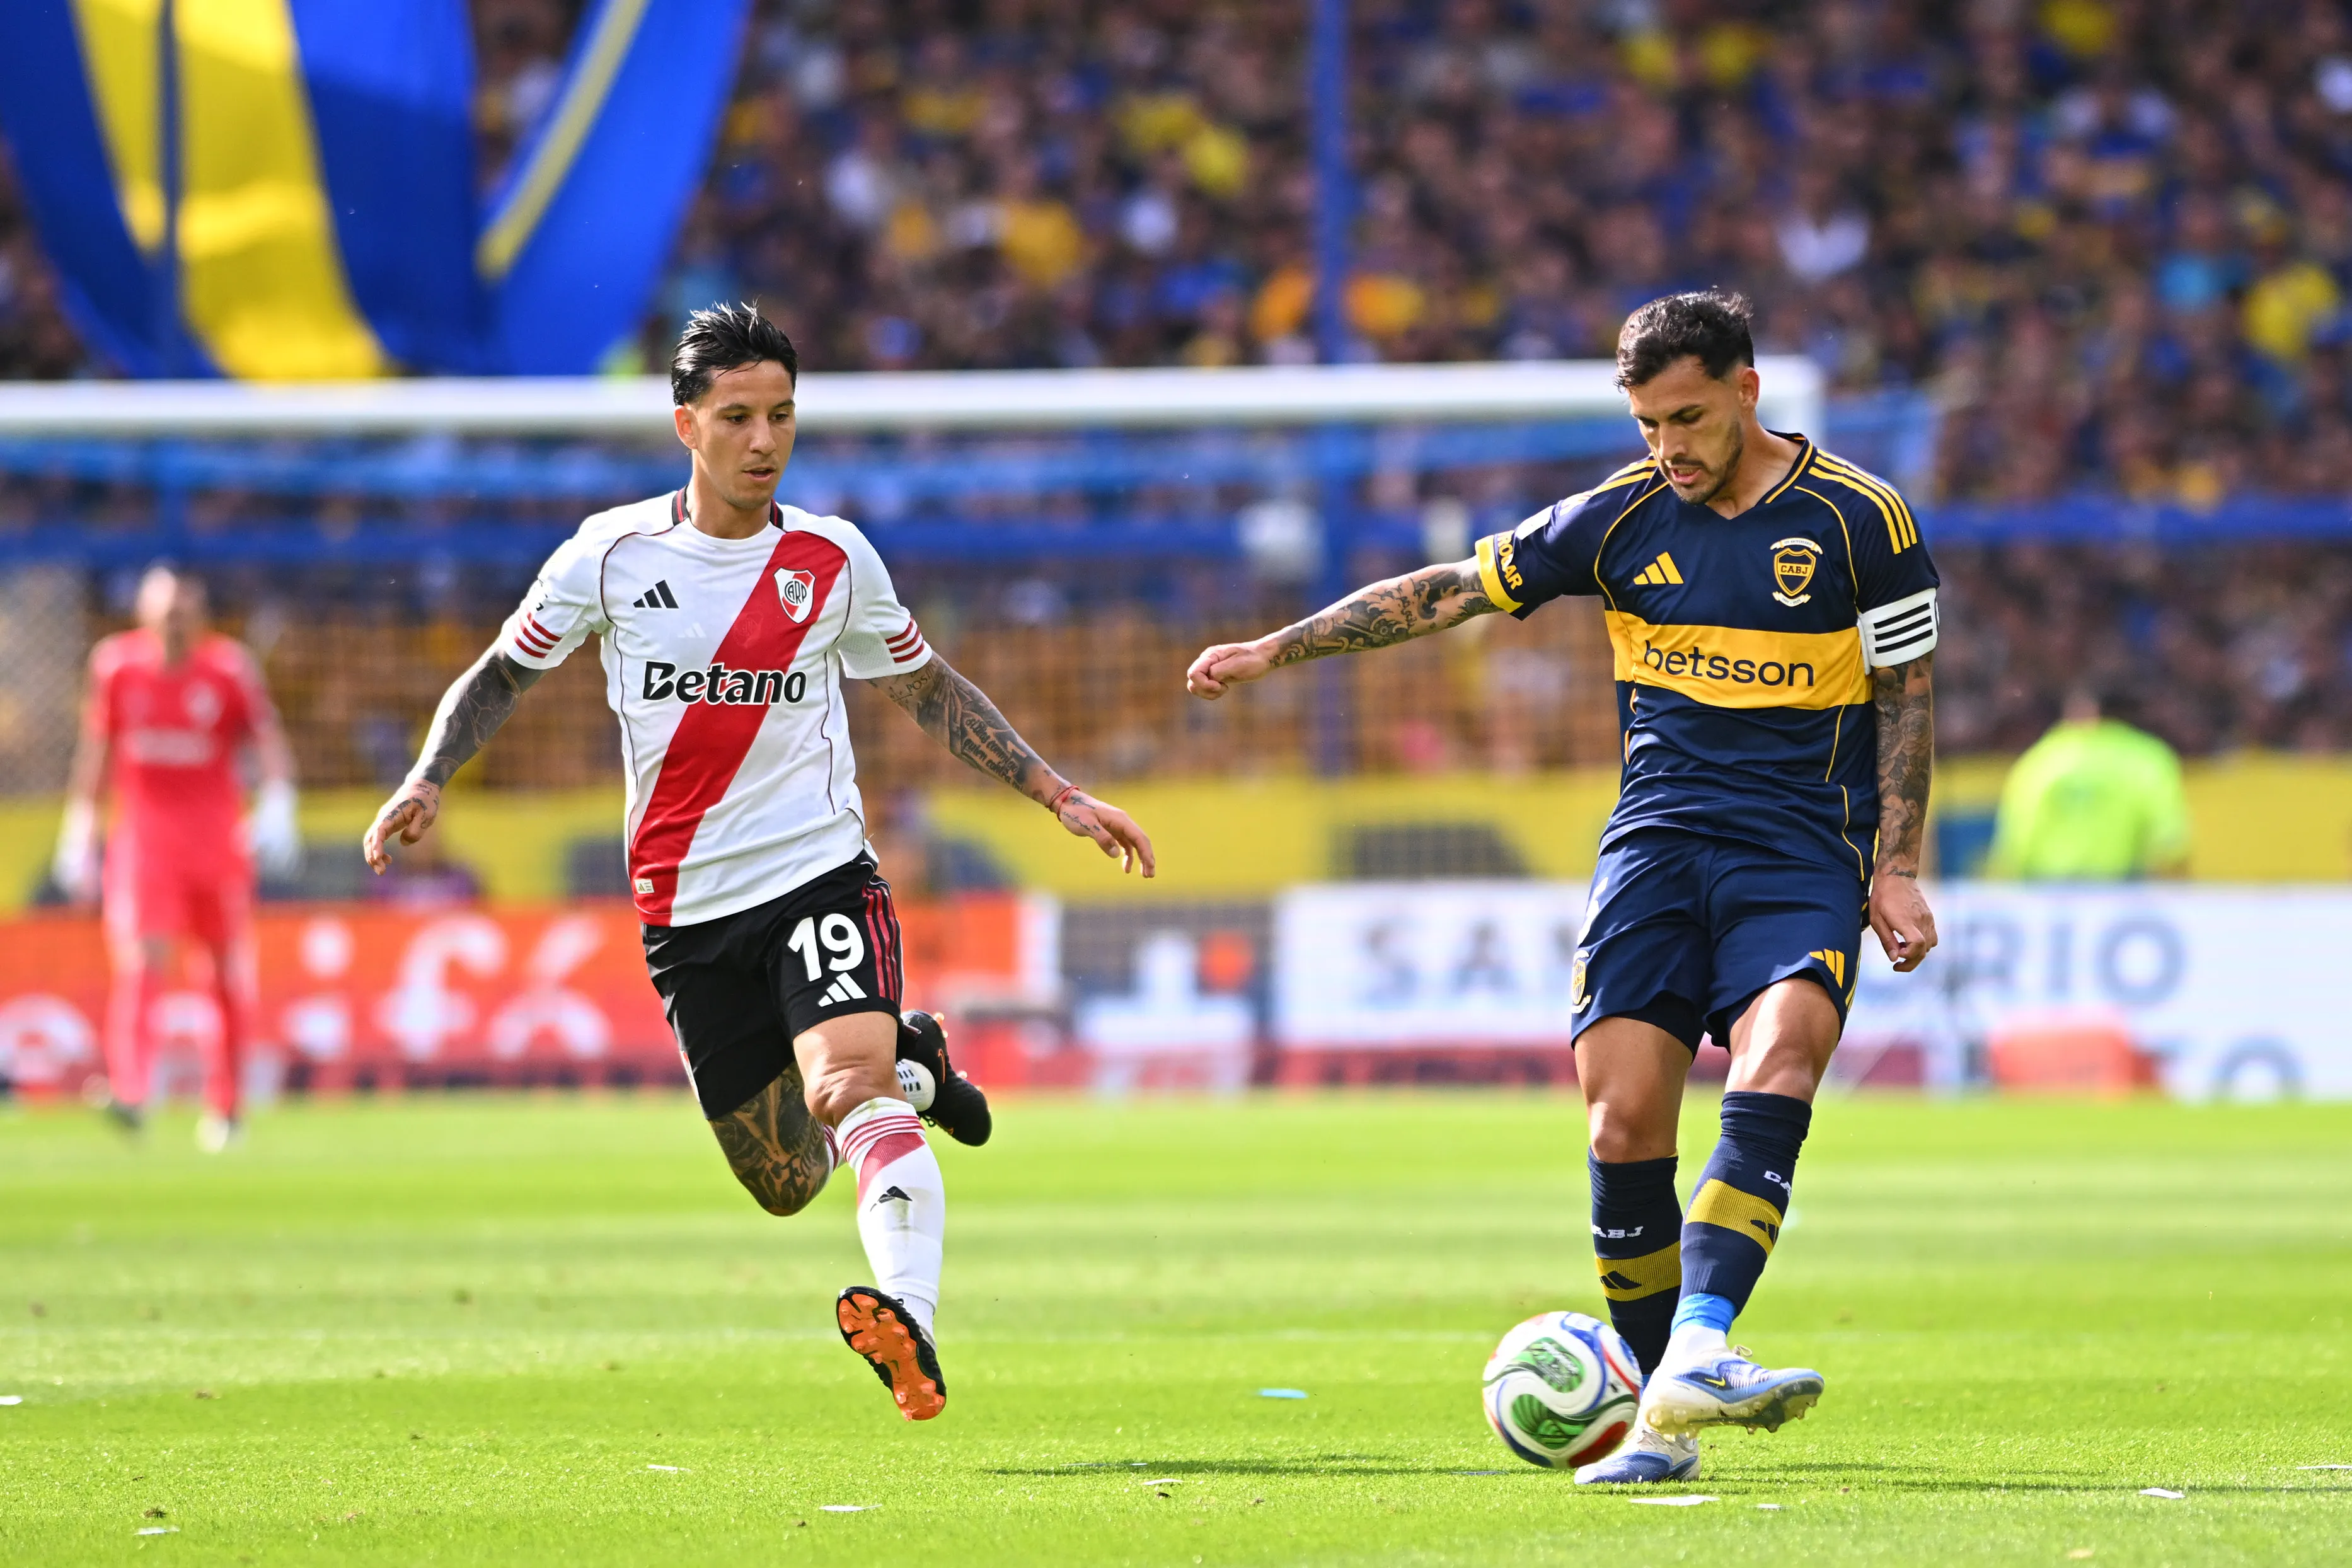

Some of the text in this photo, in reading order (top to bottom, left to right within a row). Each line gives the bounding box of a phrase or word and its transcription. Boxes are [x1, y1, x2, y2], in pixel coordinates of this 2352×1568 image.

[1780, 565, 1808, 575] CABJ
[784, 580, 807, 604] CARP
[1644, 640, 1815, 687] betsson
[642, 660, 807, 705] Betano
[788, 913, 865, 982] 19
[1592, 1224, 1644, 1238] ABJ
